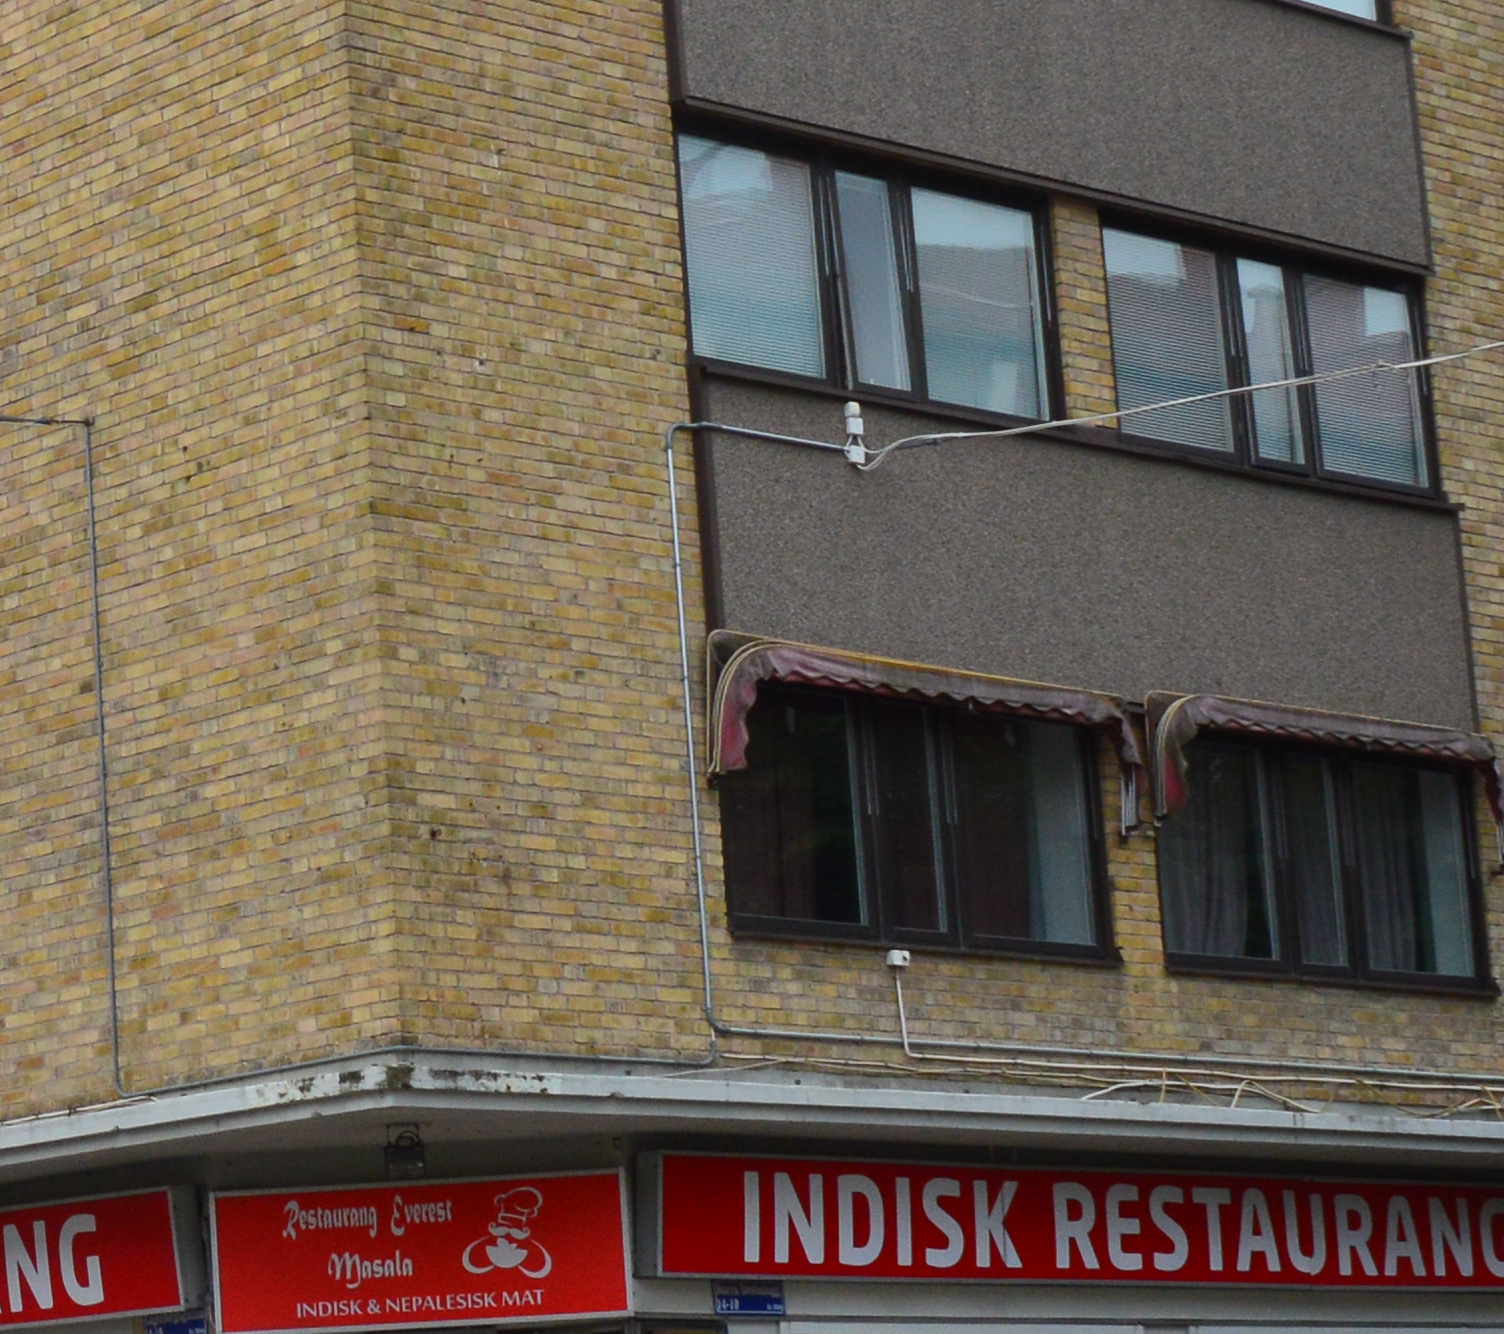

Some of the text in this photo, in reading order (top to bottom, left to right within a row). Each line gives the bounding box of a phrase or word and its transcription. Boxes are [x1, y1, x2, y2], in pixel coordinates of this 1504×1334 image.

[283, 1194, 453, 1240] Restaurang Everest
[743, 1170, 1020, 1269] INDISK
[328, 1250, 414, 1289] Masala
[296, 1289, 545, 1318] INDISK & NEPALESISK MAT
